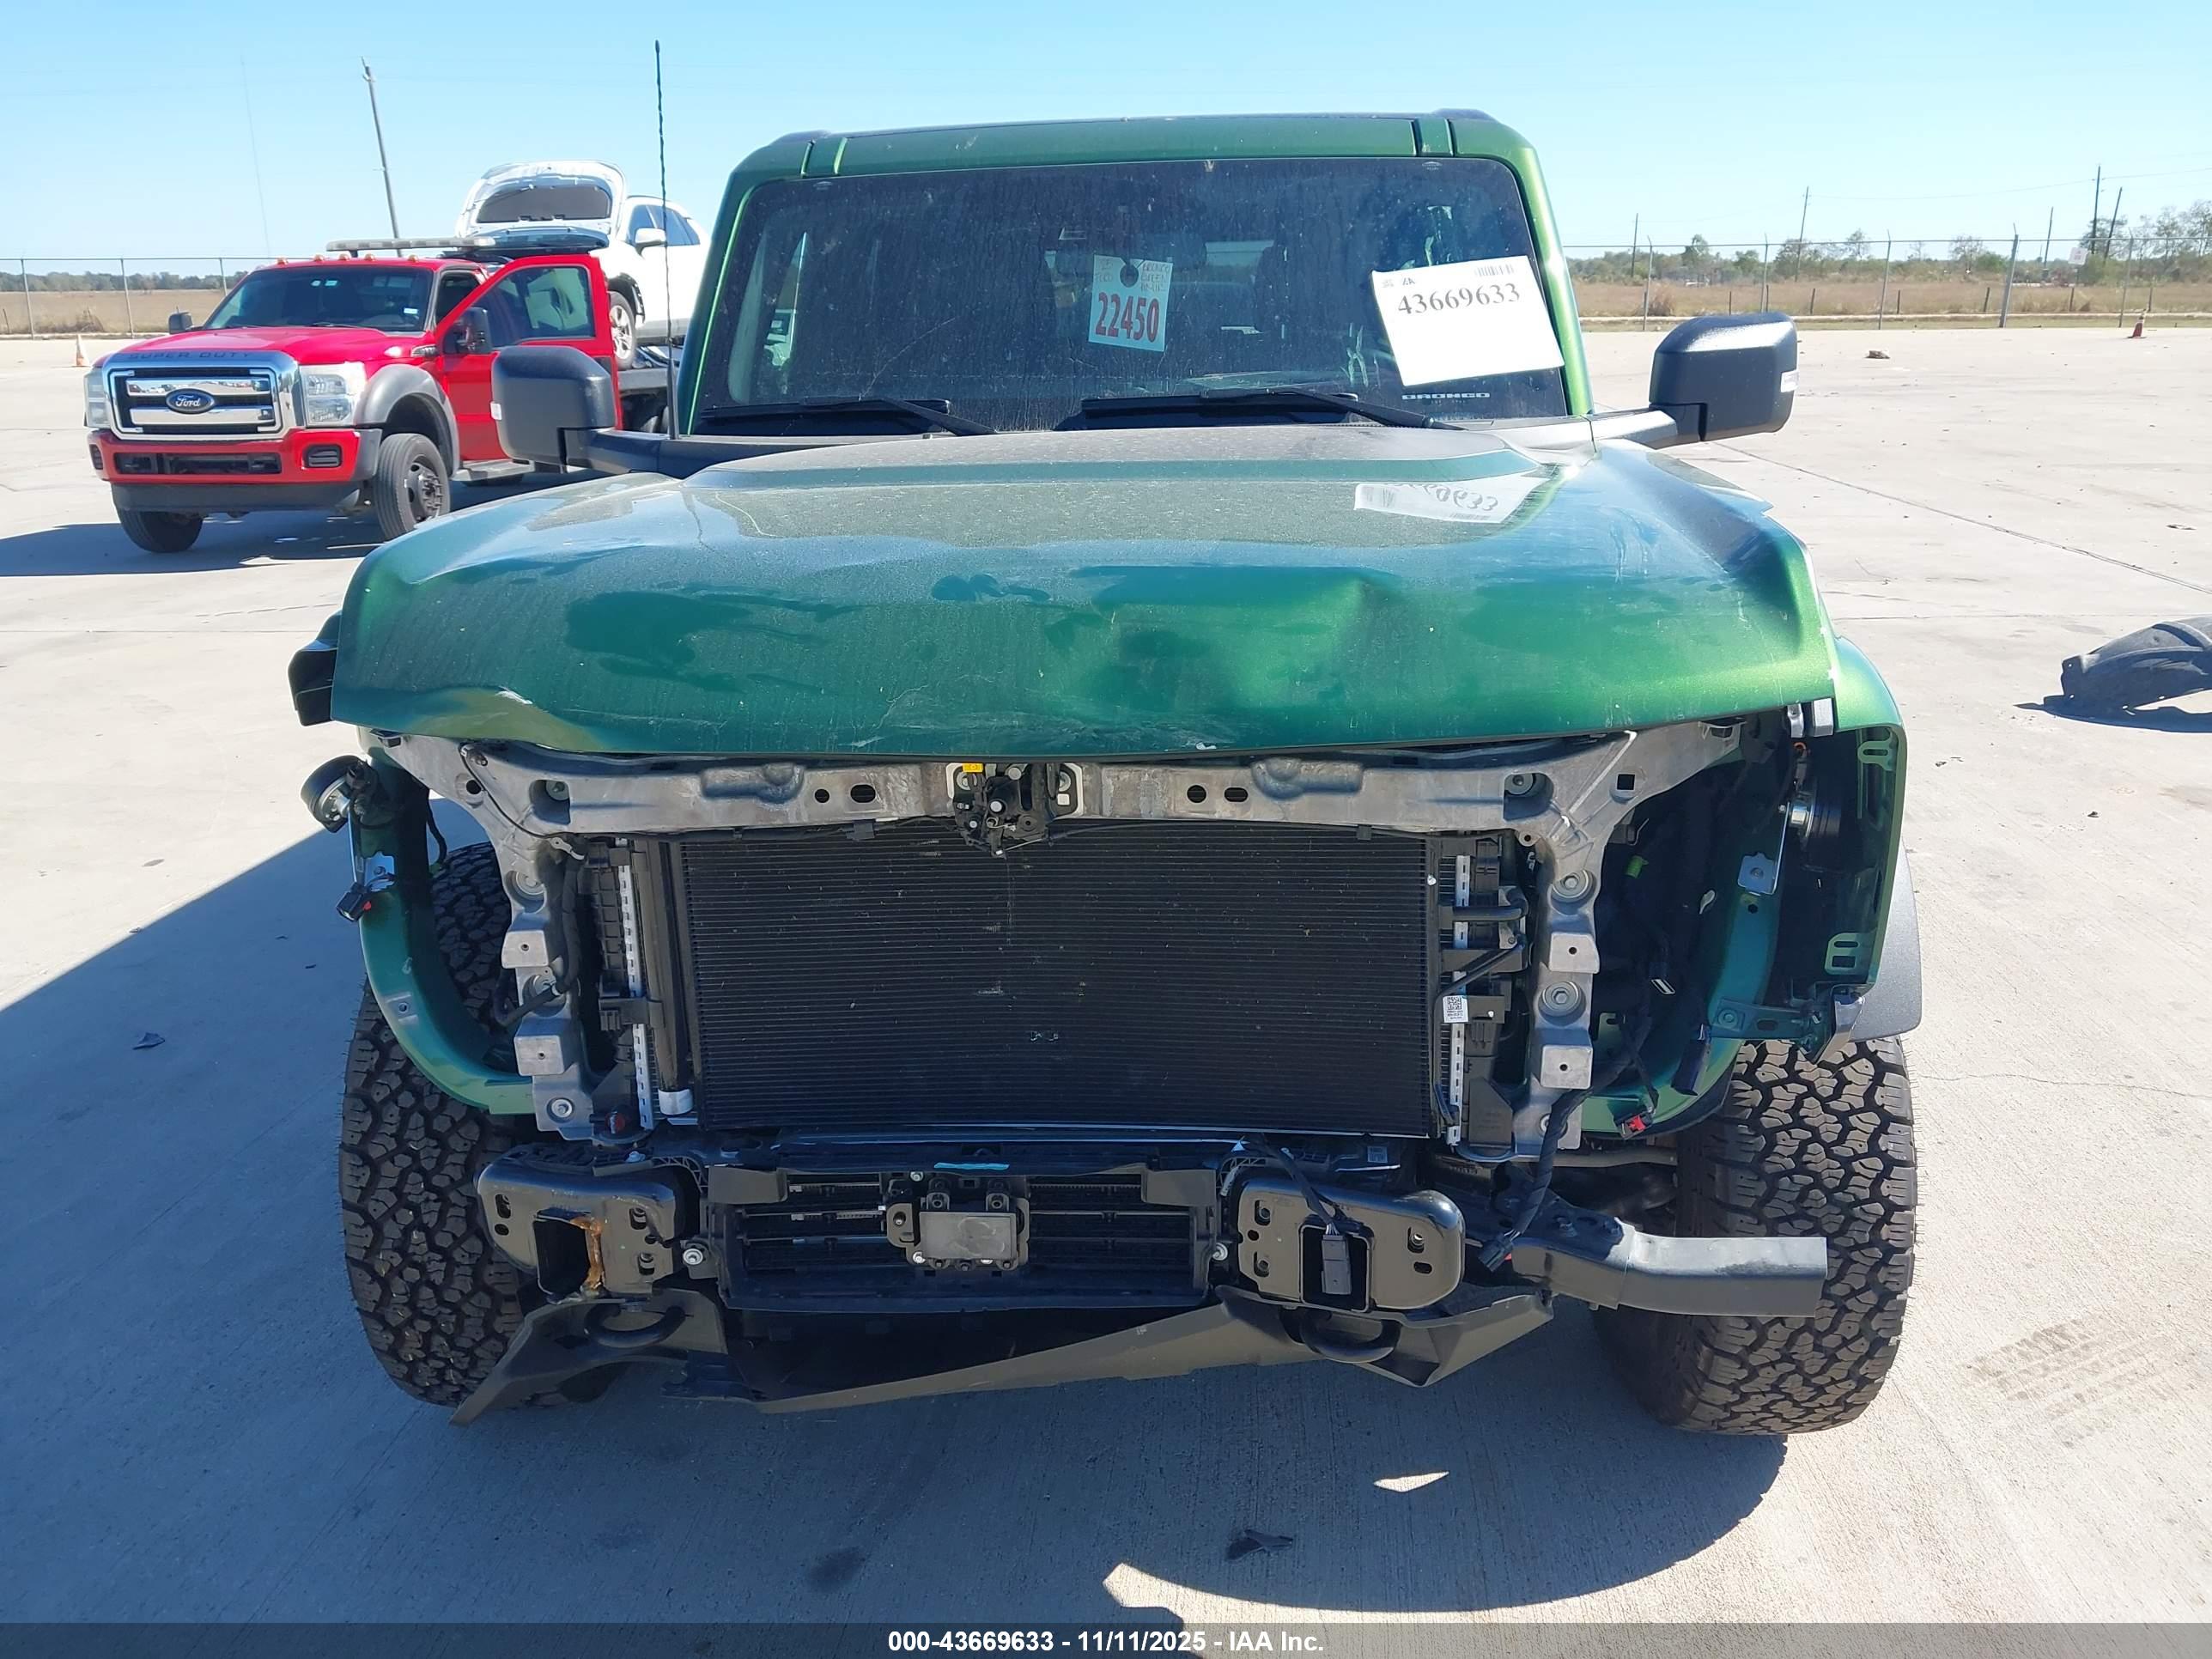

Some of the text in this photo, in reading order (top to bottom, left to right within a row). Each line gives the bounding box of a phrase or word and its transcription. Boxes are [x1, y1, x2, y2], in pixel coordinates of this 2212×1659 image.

[1398, 283, 1521, 315] 43669633
[1095, 292, 1159, 343] 22450
[174, 394, 202, 408] Ford
